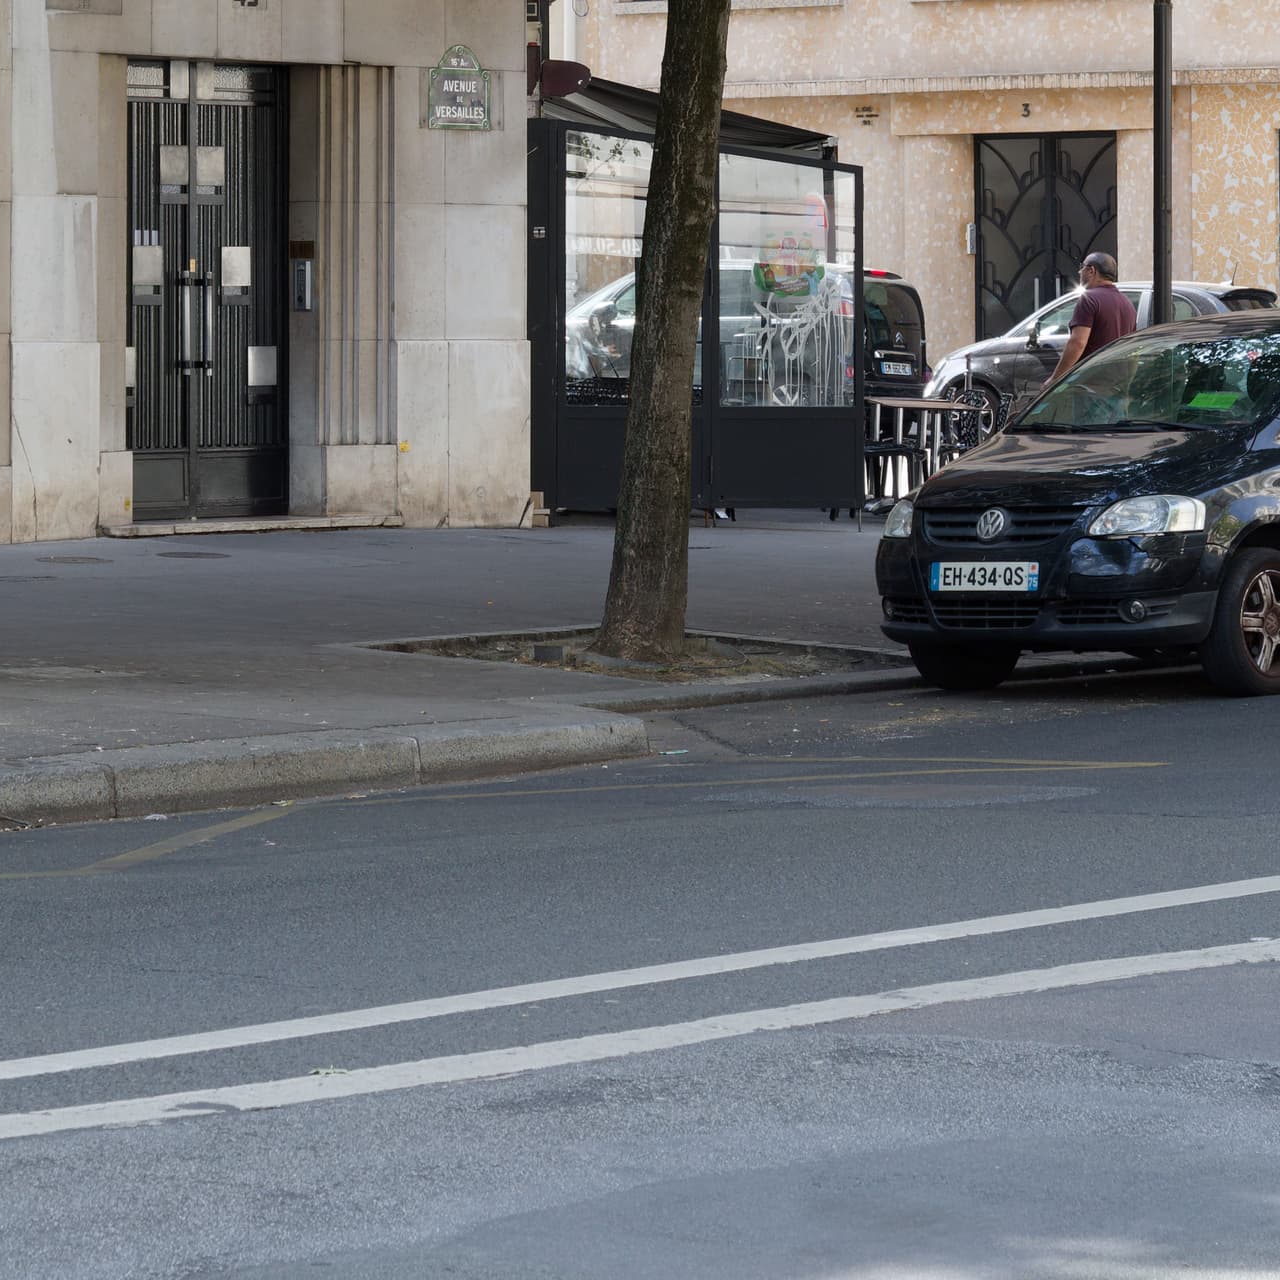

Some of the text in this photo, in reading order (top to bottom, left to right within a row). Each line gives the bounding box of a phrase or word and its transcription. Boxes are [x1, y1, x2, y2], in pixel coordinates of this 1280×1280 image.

[443, 80, 477, 93] AVENUE
[435, 106, 484, 119] VERSAILLES
[1021, 103, 1030, 117] 3
[1028, 577, 1038, 588] 75
